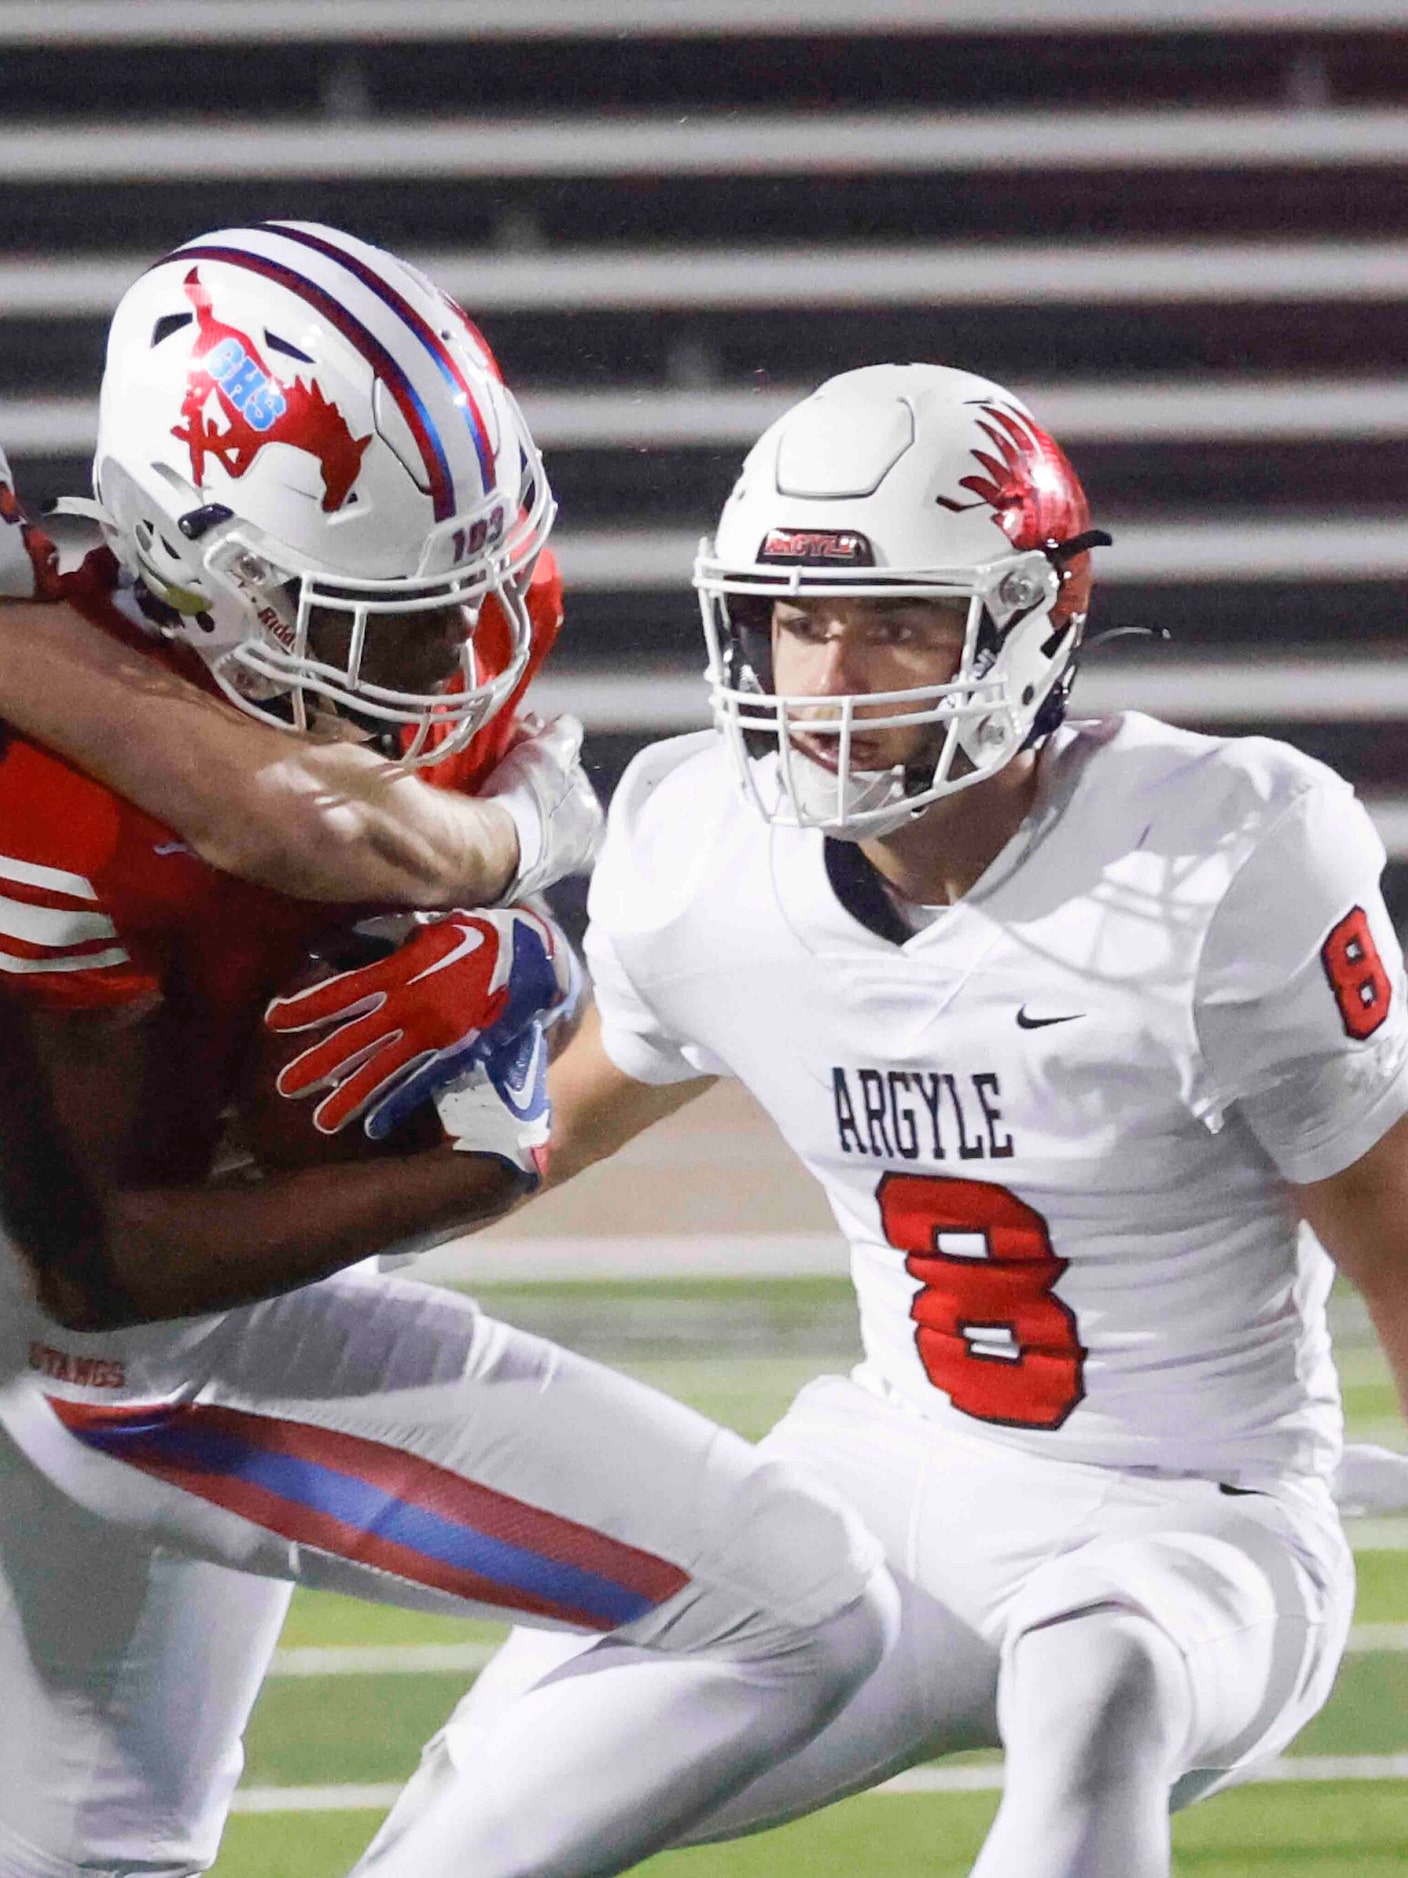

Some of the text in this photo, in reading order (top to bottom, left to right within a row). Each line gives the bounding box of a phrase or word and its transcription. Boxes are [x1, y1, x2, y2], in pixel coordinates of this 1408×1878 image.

[205, 337, 287, 432] GHS
[257, 606, 296, 648] Ridd
[1320, 904, 1392, 1041] 8
[831, 1066, 1014, 1160] ARGYLE
[876, 1170, 1088, 1430] 8
